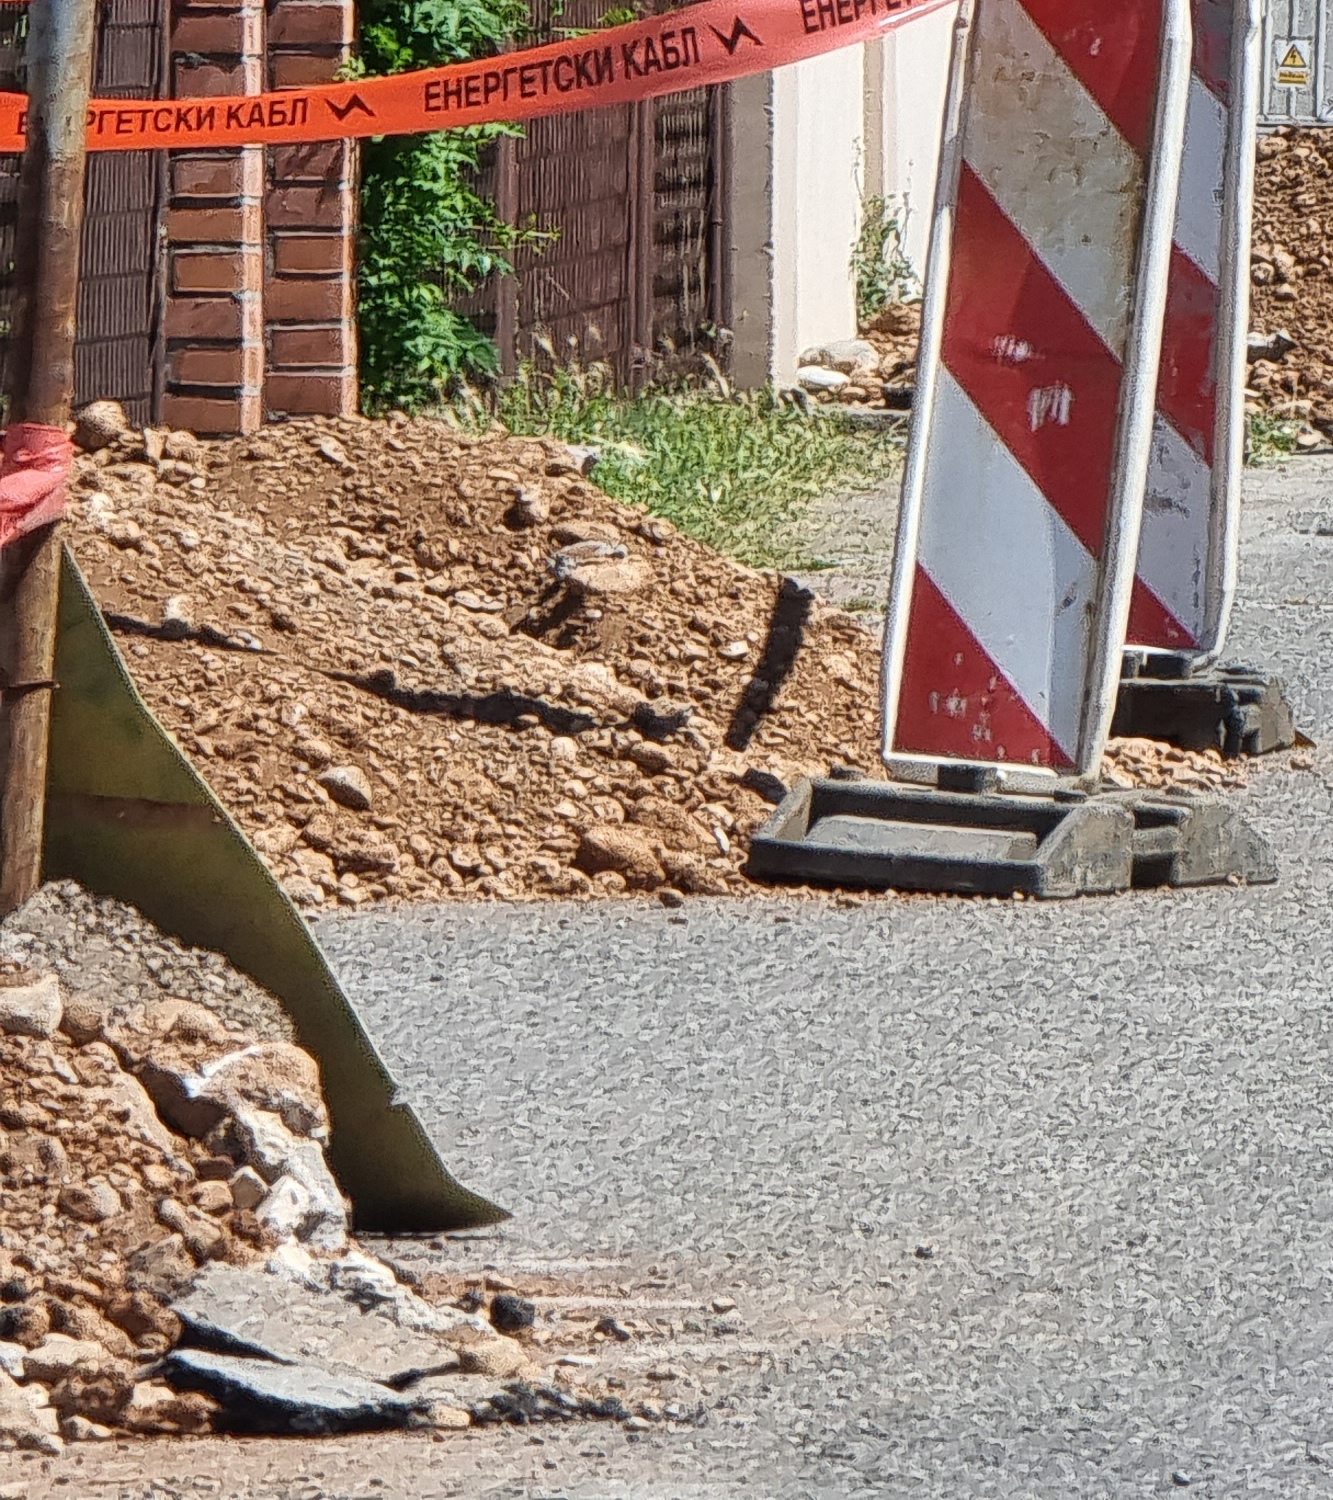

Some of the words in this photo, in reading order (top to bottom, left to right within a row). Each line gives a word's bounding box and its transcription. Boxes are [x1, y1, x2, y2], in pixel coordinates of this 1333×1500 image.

[424, 46, 613, 112] ЕНЕРГЕТСКИ
[622, 26, 700, 80] КАБЛ
[14, 105, 214, 135] ЕРГЕТСКИ
[226, 98, 308, 129] КАБЛ
